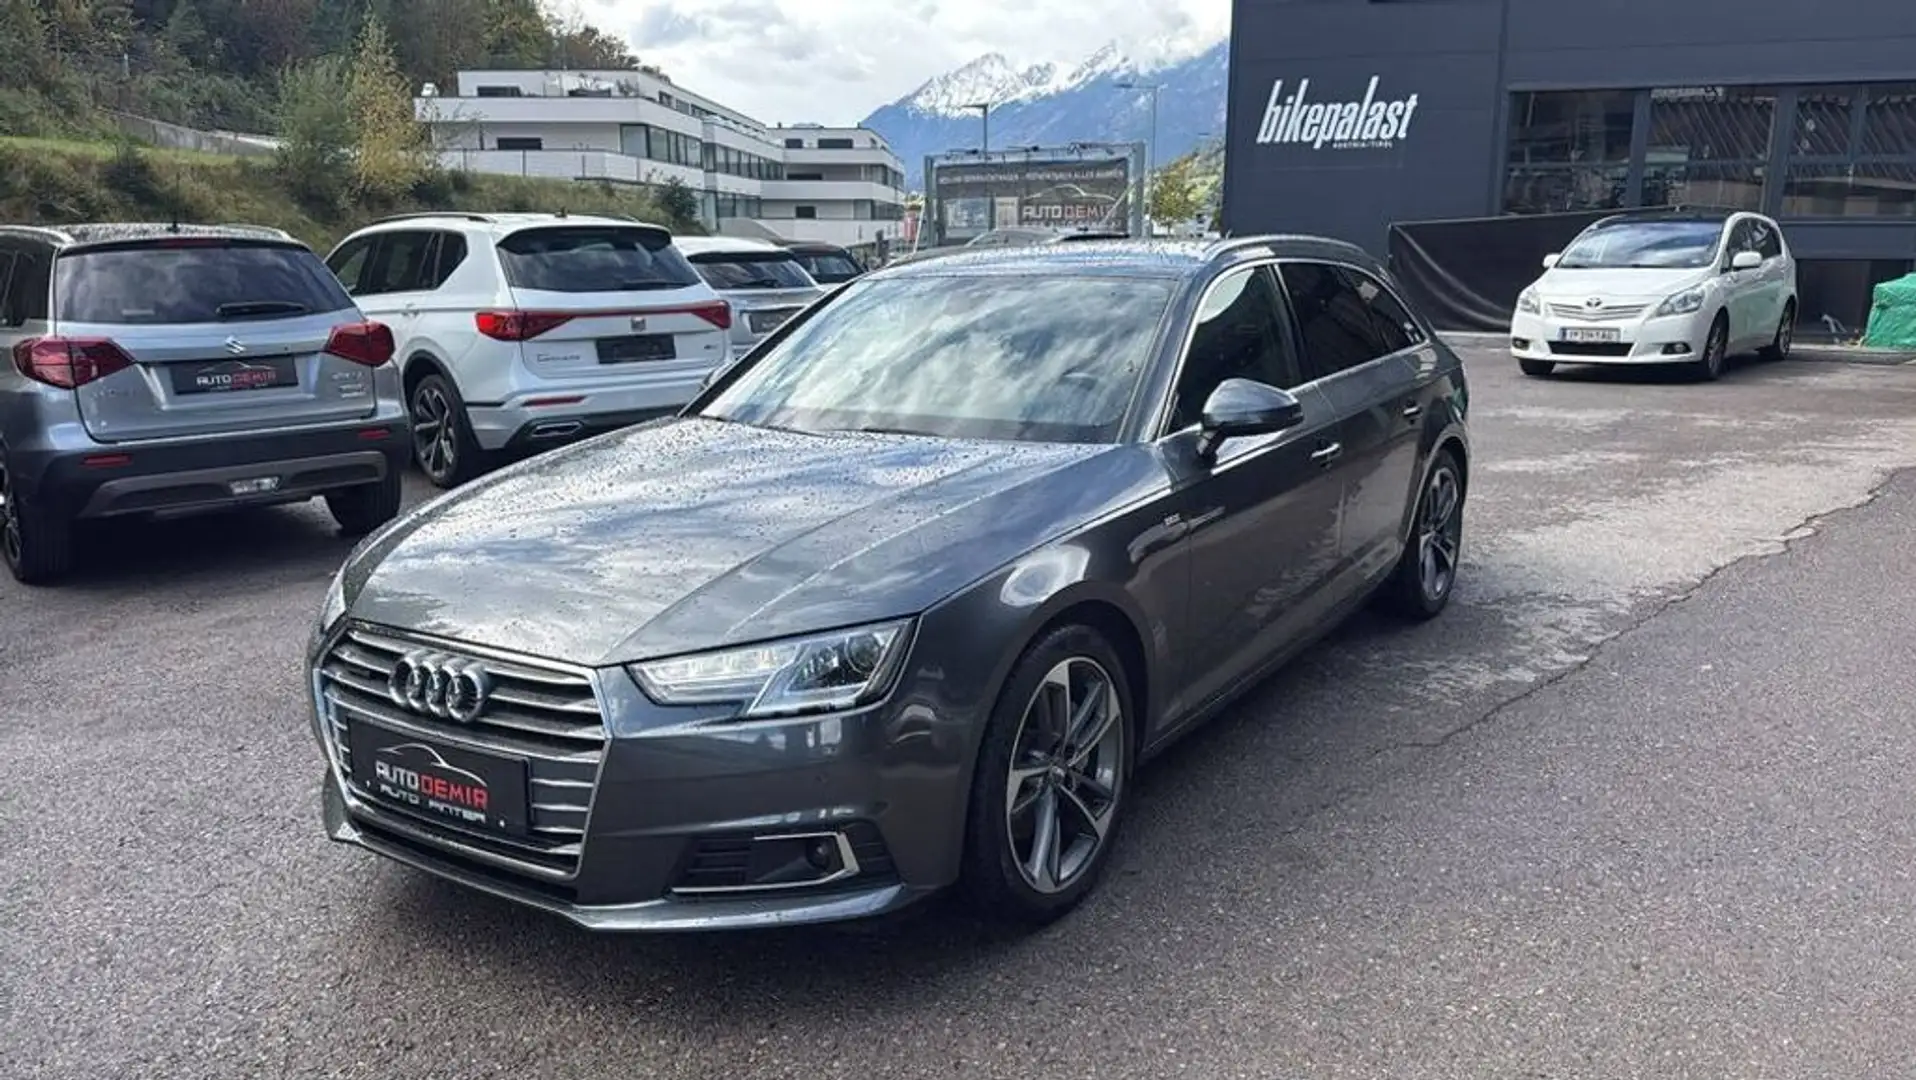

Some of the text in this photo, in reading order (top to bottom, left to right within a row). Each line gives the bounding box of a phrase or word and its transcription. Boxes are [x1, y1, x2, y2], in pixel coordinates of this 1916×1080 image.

[1256, 75, 1418, 149] bikepalast
[375, 759, 489, 809] AUTODEMIR
[379, 784, 421, 805] AUTO
